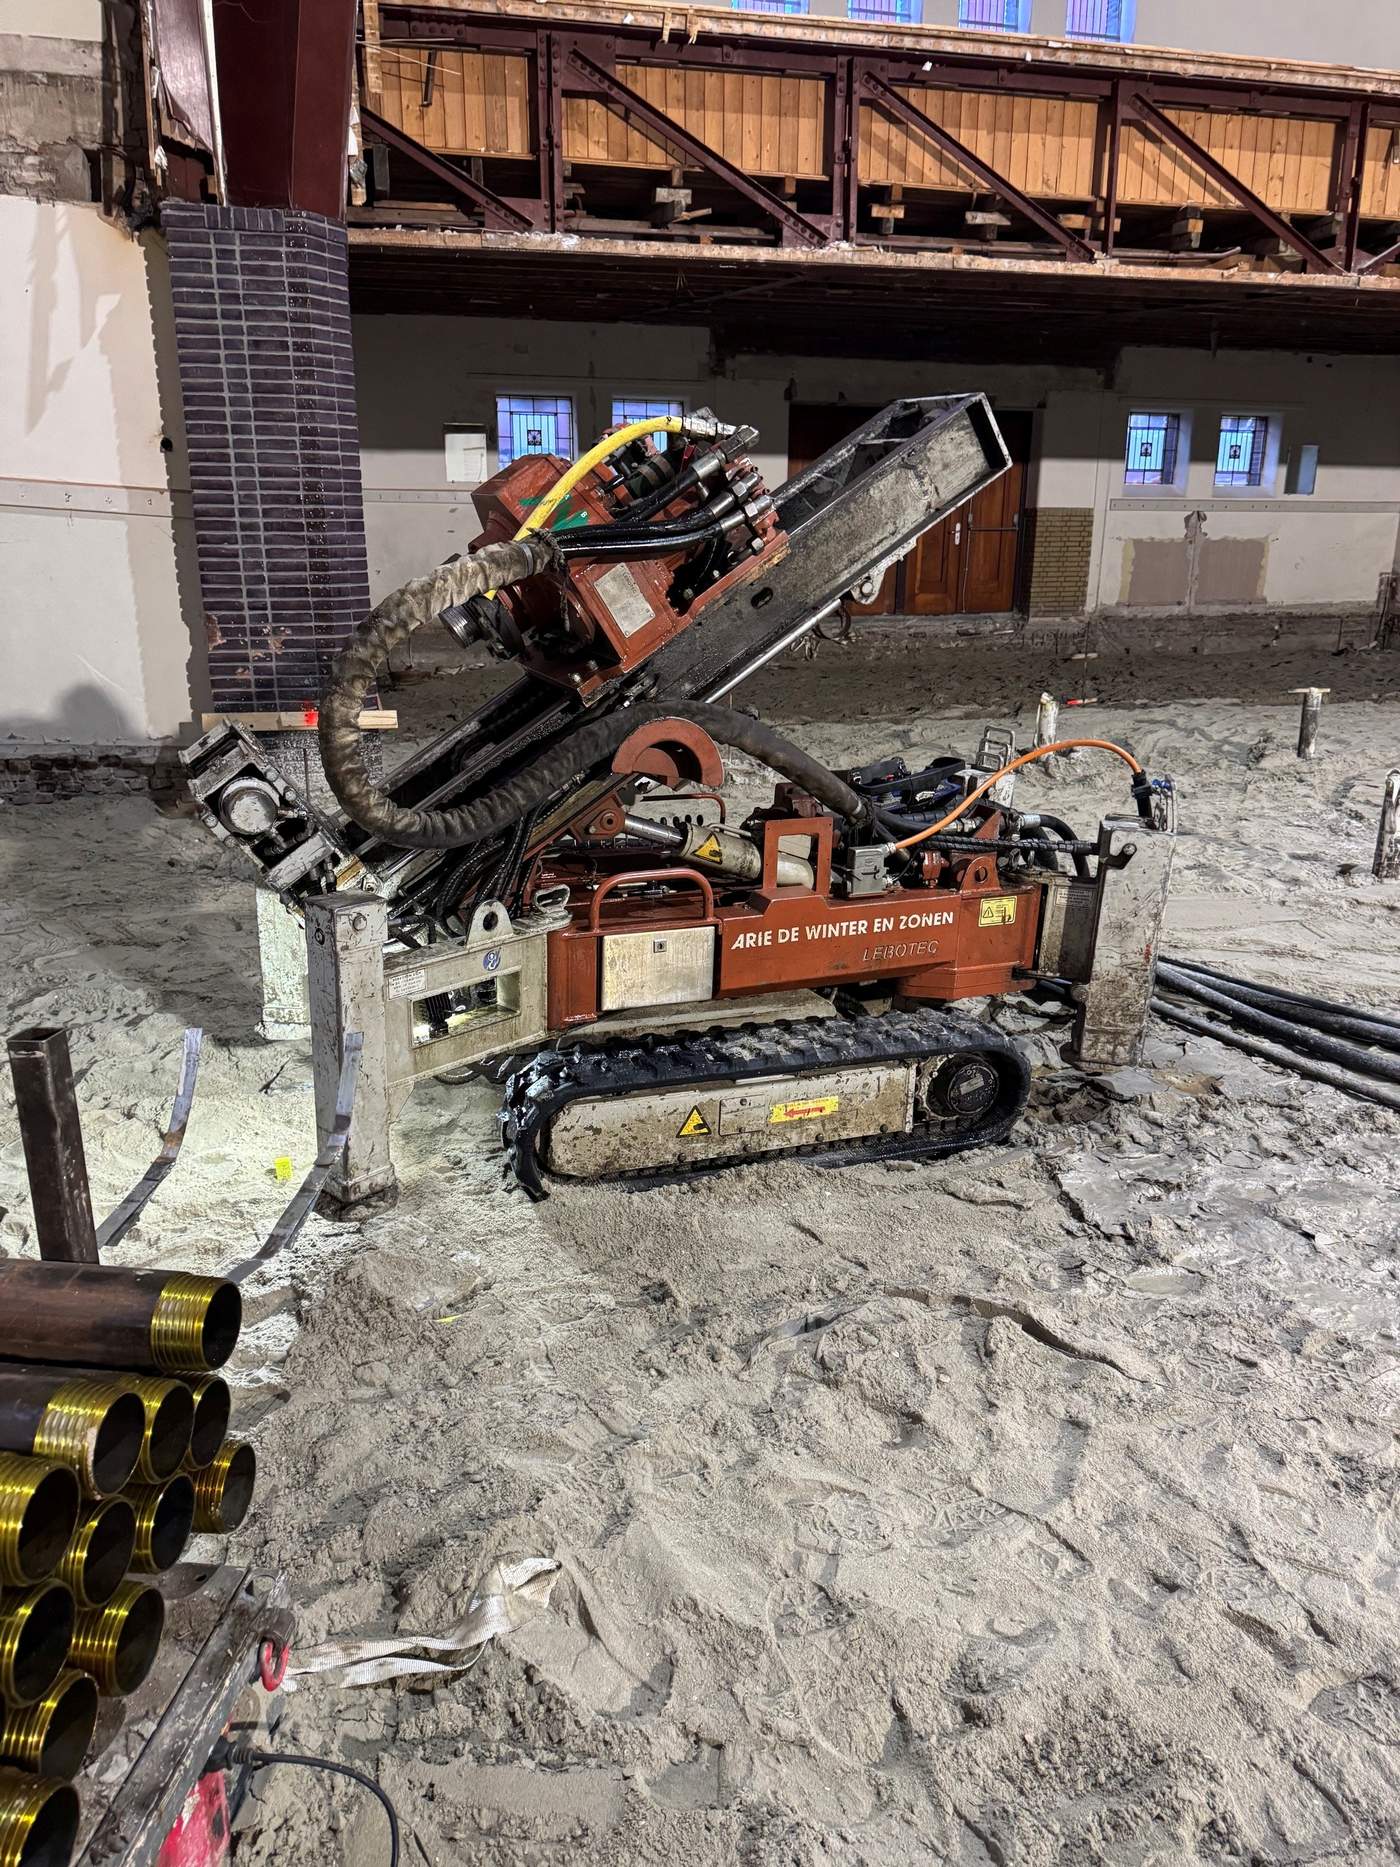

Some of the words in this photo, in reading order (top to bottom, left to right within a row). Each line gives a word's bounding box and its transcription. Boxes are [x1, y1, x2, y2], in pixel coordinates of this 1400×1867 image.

[731, 930, 773, 950] ARIE
[777, 926, 800, 944] DE
[805, 919, 868, 940] WINTER
[873, 916, 894, 933] EN
[899, 911, 954, 930] ZONEN
[862, 940, 939, 961] LEBOTEC
